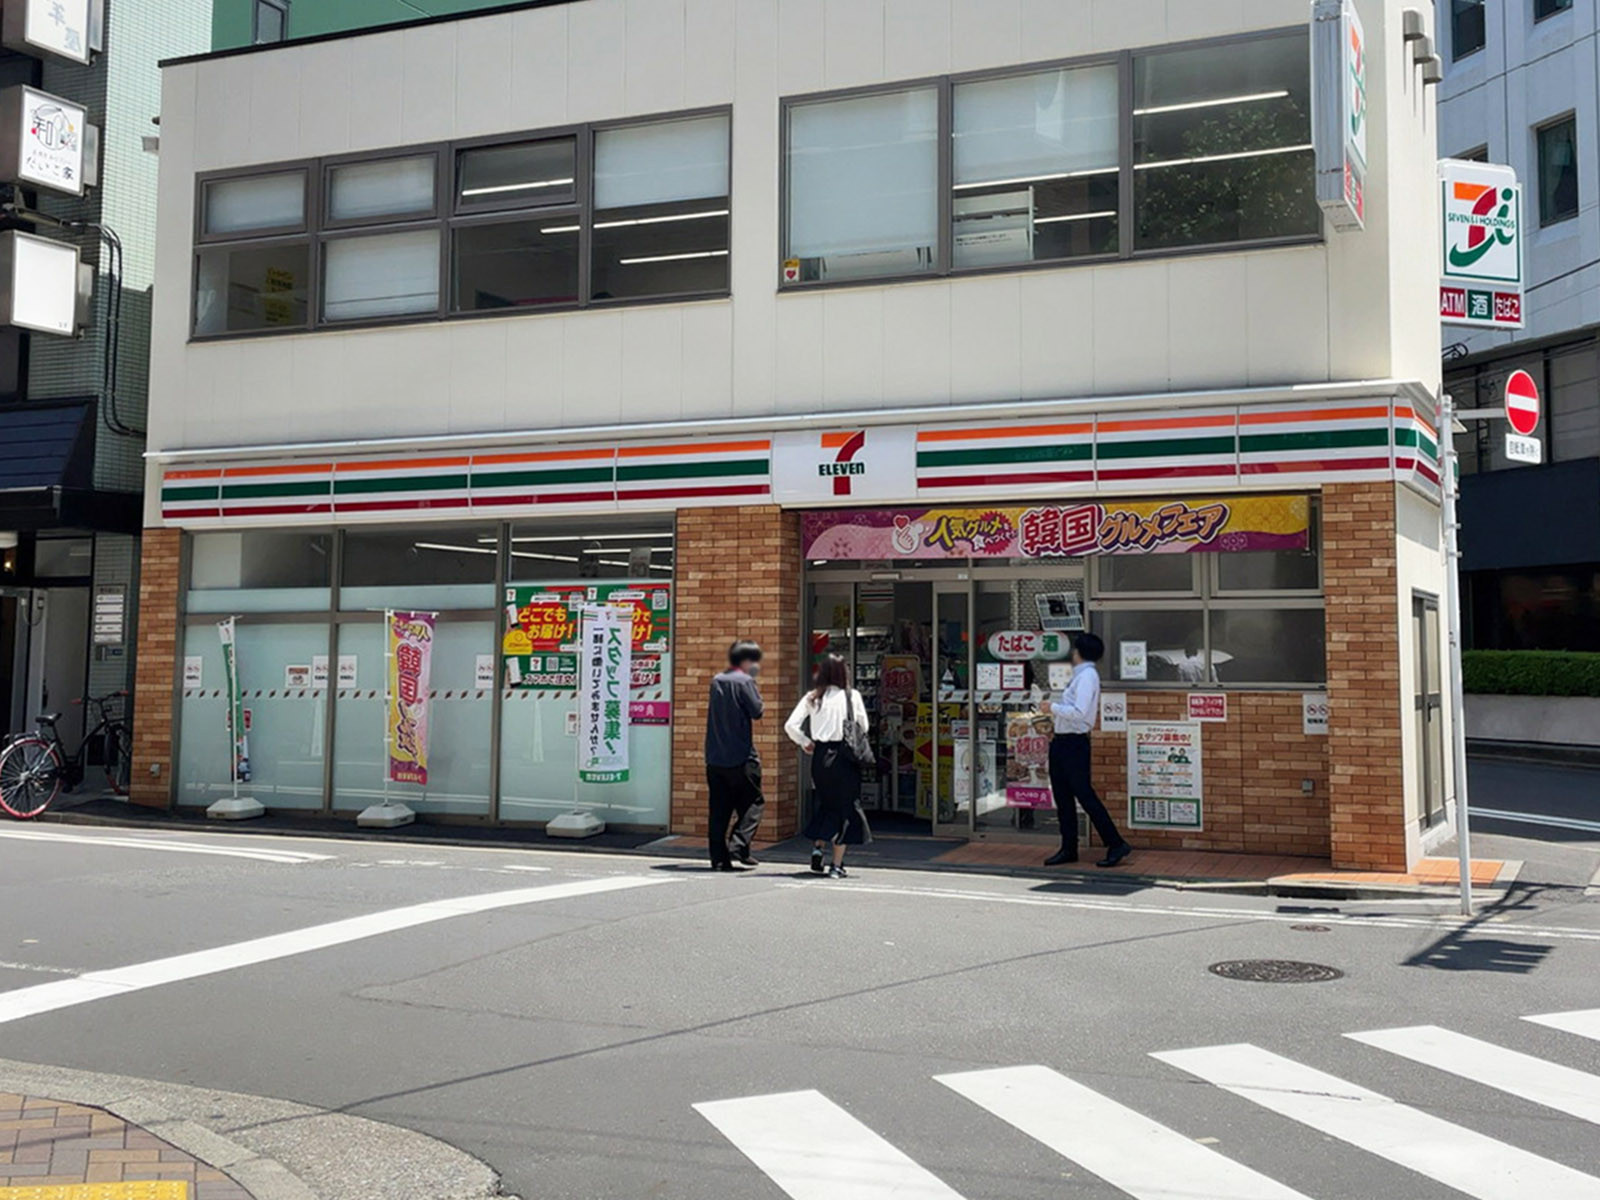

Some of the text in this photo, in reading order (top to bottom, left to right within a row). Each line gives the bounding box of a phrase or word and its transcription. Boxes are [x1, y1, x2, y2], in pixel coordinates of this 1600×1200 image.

[1479, 214, 1515, 229] HOLDINGS
[1441, 293, 1465, 313] ATM
[1472, 294, 1489, 316] 酒
[1495, 296, 1520, 318] たばこ
[518, 607, 567, 622] どこでも
[527, 622, 574, 639] お届け!
[998, 634, 1035, 652] たばこ
[1041, 634, 1059, 652] 酒
